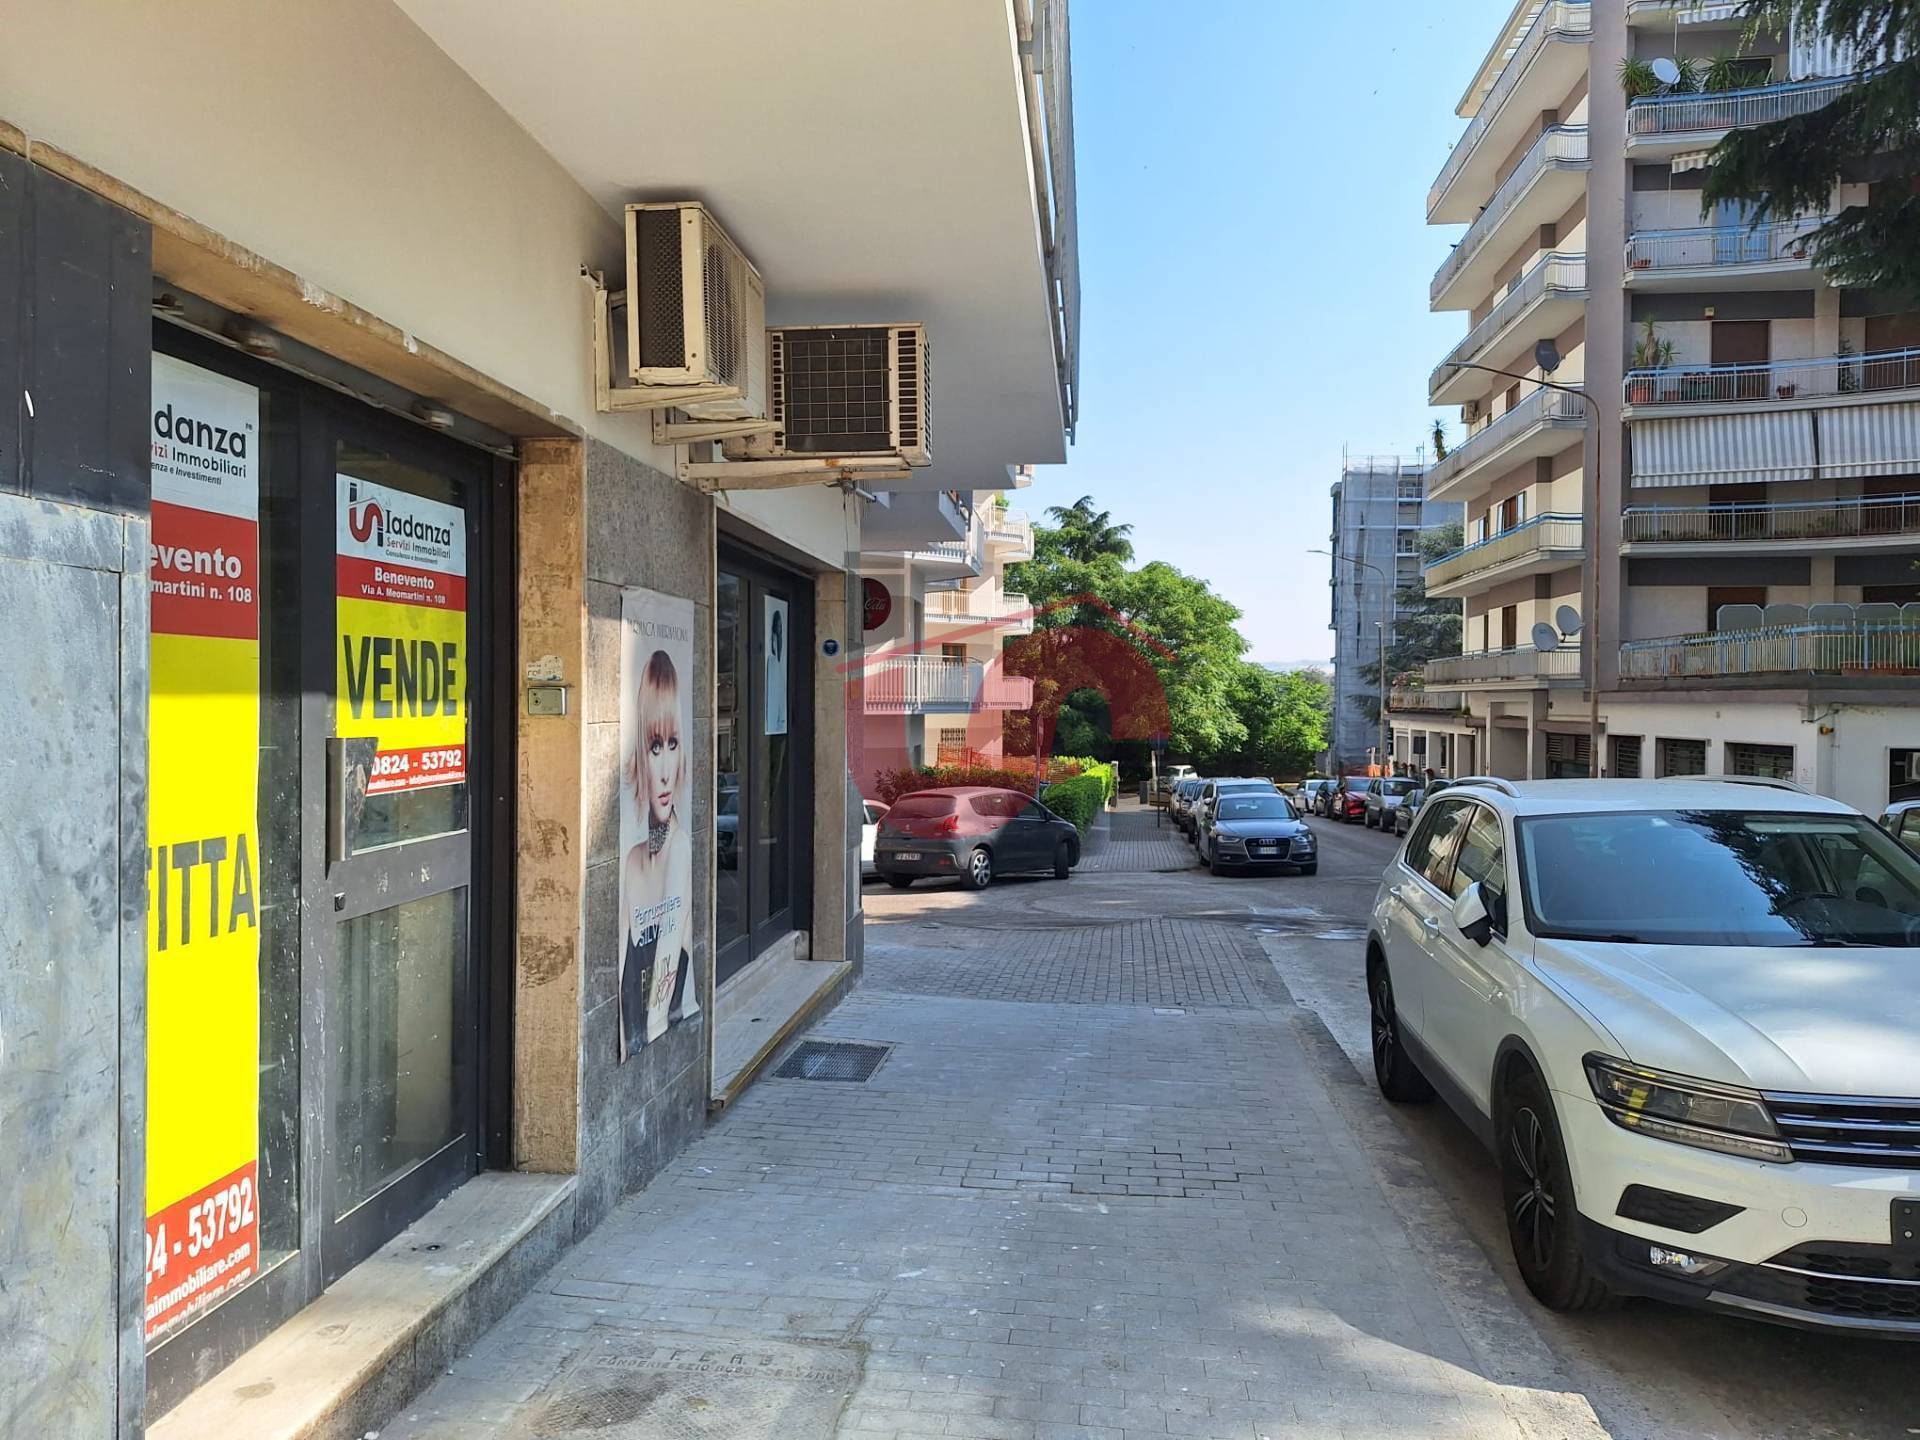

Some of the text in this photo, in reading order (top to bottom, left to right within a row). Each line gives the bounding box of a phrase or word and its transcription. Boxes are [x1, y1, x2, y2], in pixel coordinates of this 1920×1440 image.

[154, 403, 246, 459] danza
[172, 446, 246, 478] Immobiliari
[175, 466, 221, 485] Investimenti
[385, 509, 451, 546] Iadanza
[386, 536, 451, 559] Servizi Immobiliari
[374, 566, 435, 590] Benevento
[209, 586, 223, 600] n.
[227, 585, 252, 603] 108
[361, 584, 375, 595] Via
[376, 586, 384, 596] A.
[386, 587, 425, 602] Meomartini
[343, 634, 457, 720] VENDE
[422, 749, 462, 771] 53792
[148, 833, 256, 952] ITTA
[188, 1176, 254, 1258] 53792
